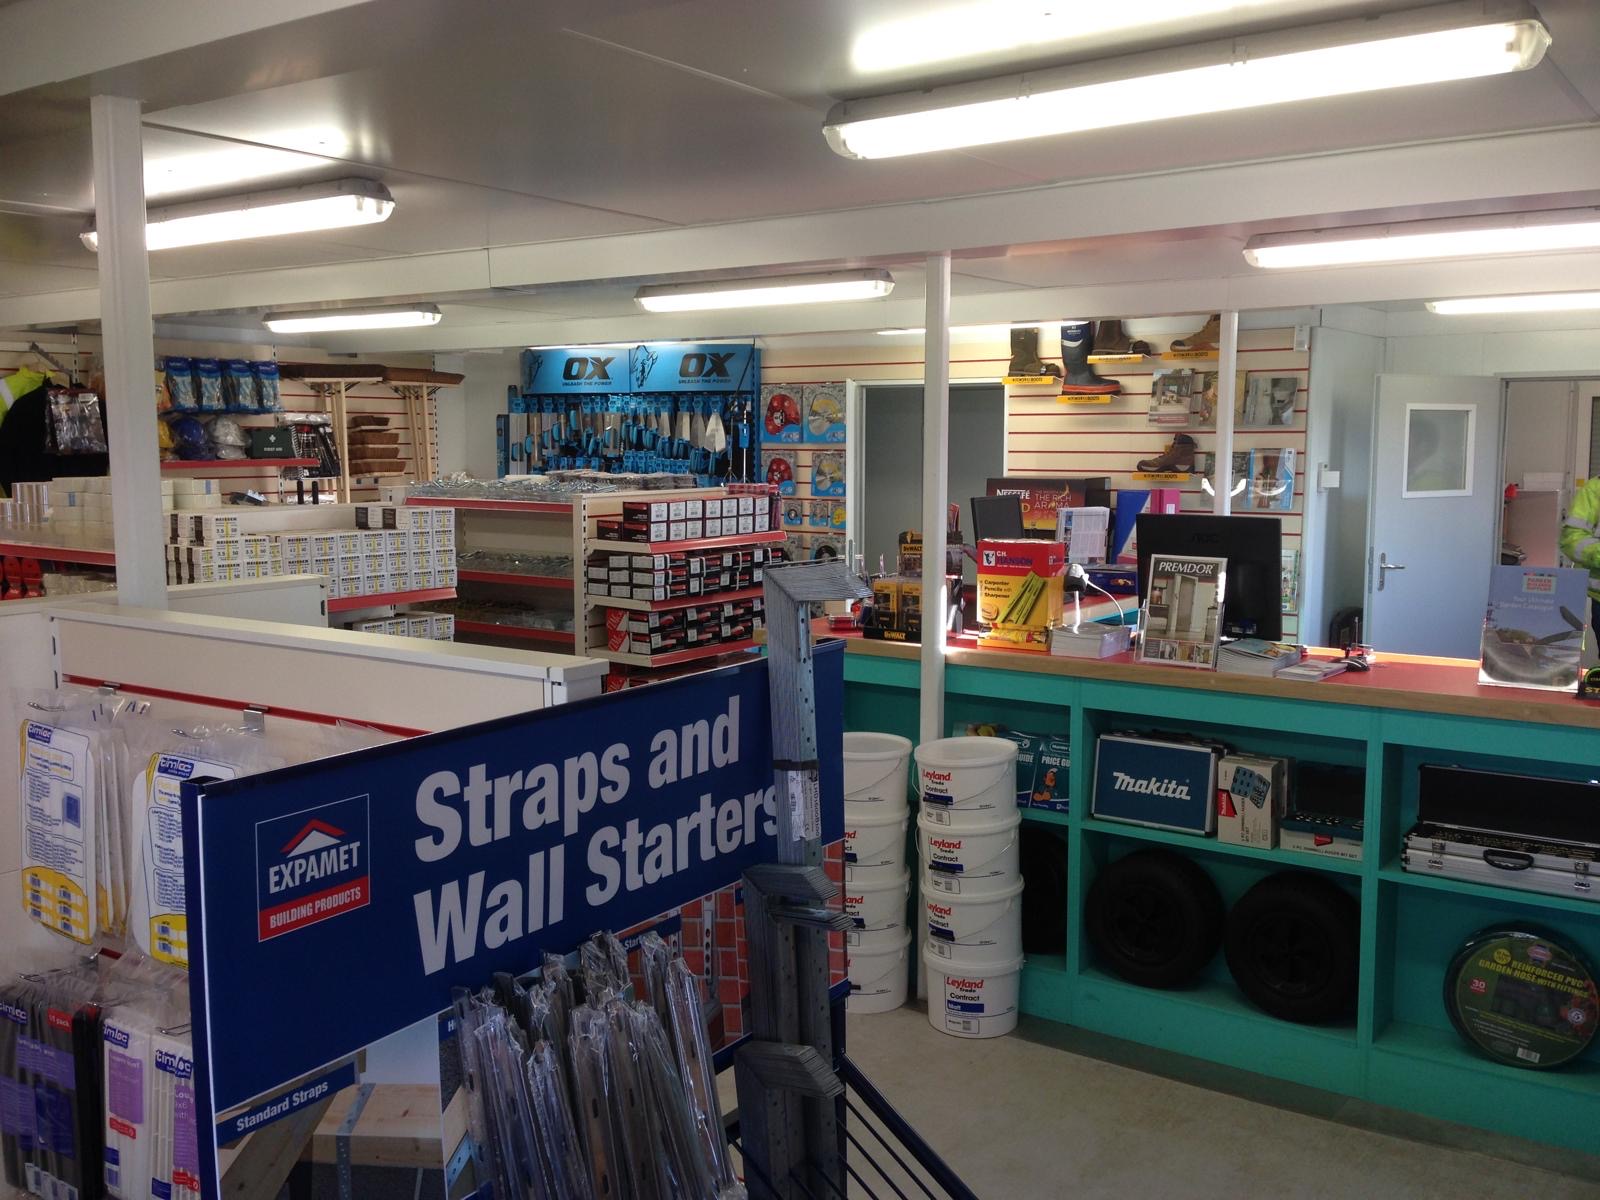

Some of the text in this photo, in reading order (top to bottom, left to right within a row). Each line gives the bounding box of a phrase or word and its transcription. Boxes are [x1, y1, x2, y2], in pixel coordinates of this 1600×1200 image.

[562, 356, 616, 380] OX
[679, 353, 736, 377] OX
[1034, 494, 1072, 502] THE RICH
[1158, 562, 1214, 575] PREMDOR
[1042, 756, 1060, 766] PRICE
[415, 695, 740, 863] Straps and
[922, 768, 952, 781] Leyland
[926, 784, 948, 794] Contract
[1112, 770, 1190, 800] Makita
[930, 837, 962, 850] Leyland
[932, 853, 958, 862] Contract
[269, 841, 360, 894] EXPAMET
[413, 786, 777, 976] Wall Starters
[270, 886, 361, 929] BUILDING PRODUCTS
[927, 900, 952, 915] Leyland
[929, 916, 949, 928] Contract
[1478, 959, 1512, 975] GARDEN
[1514, 970, 1537, 982] HOSE
[1511, 960, 1564, 982] REINFORCED
[1565, 976, 1584, 988] PVC
[946, 976, 984, 990] Leyland
[1472, 979, 1486, 988] 30
[950, 992, 980, 1002] Contract
[236, 1080, 329, 1132] Standard Straps
